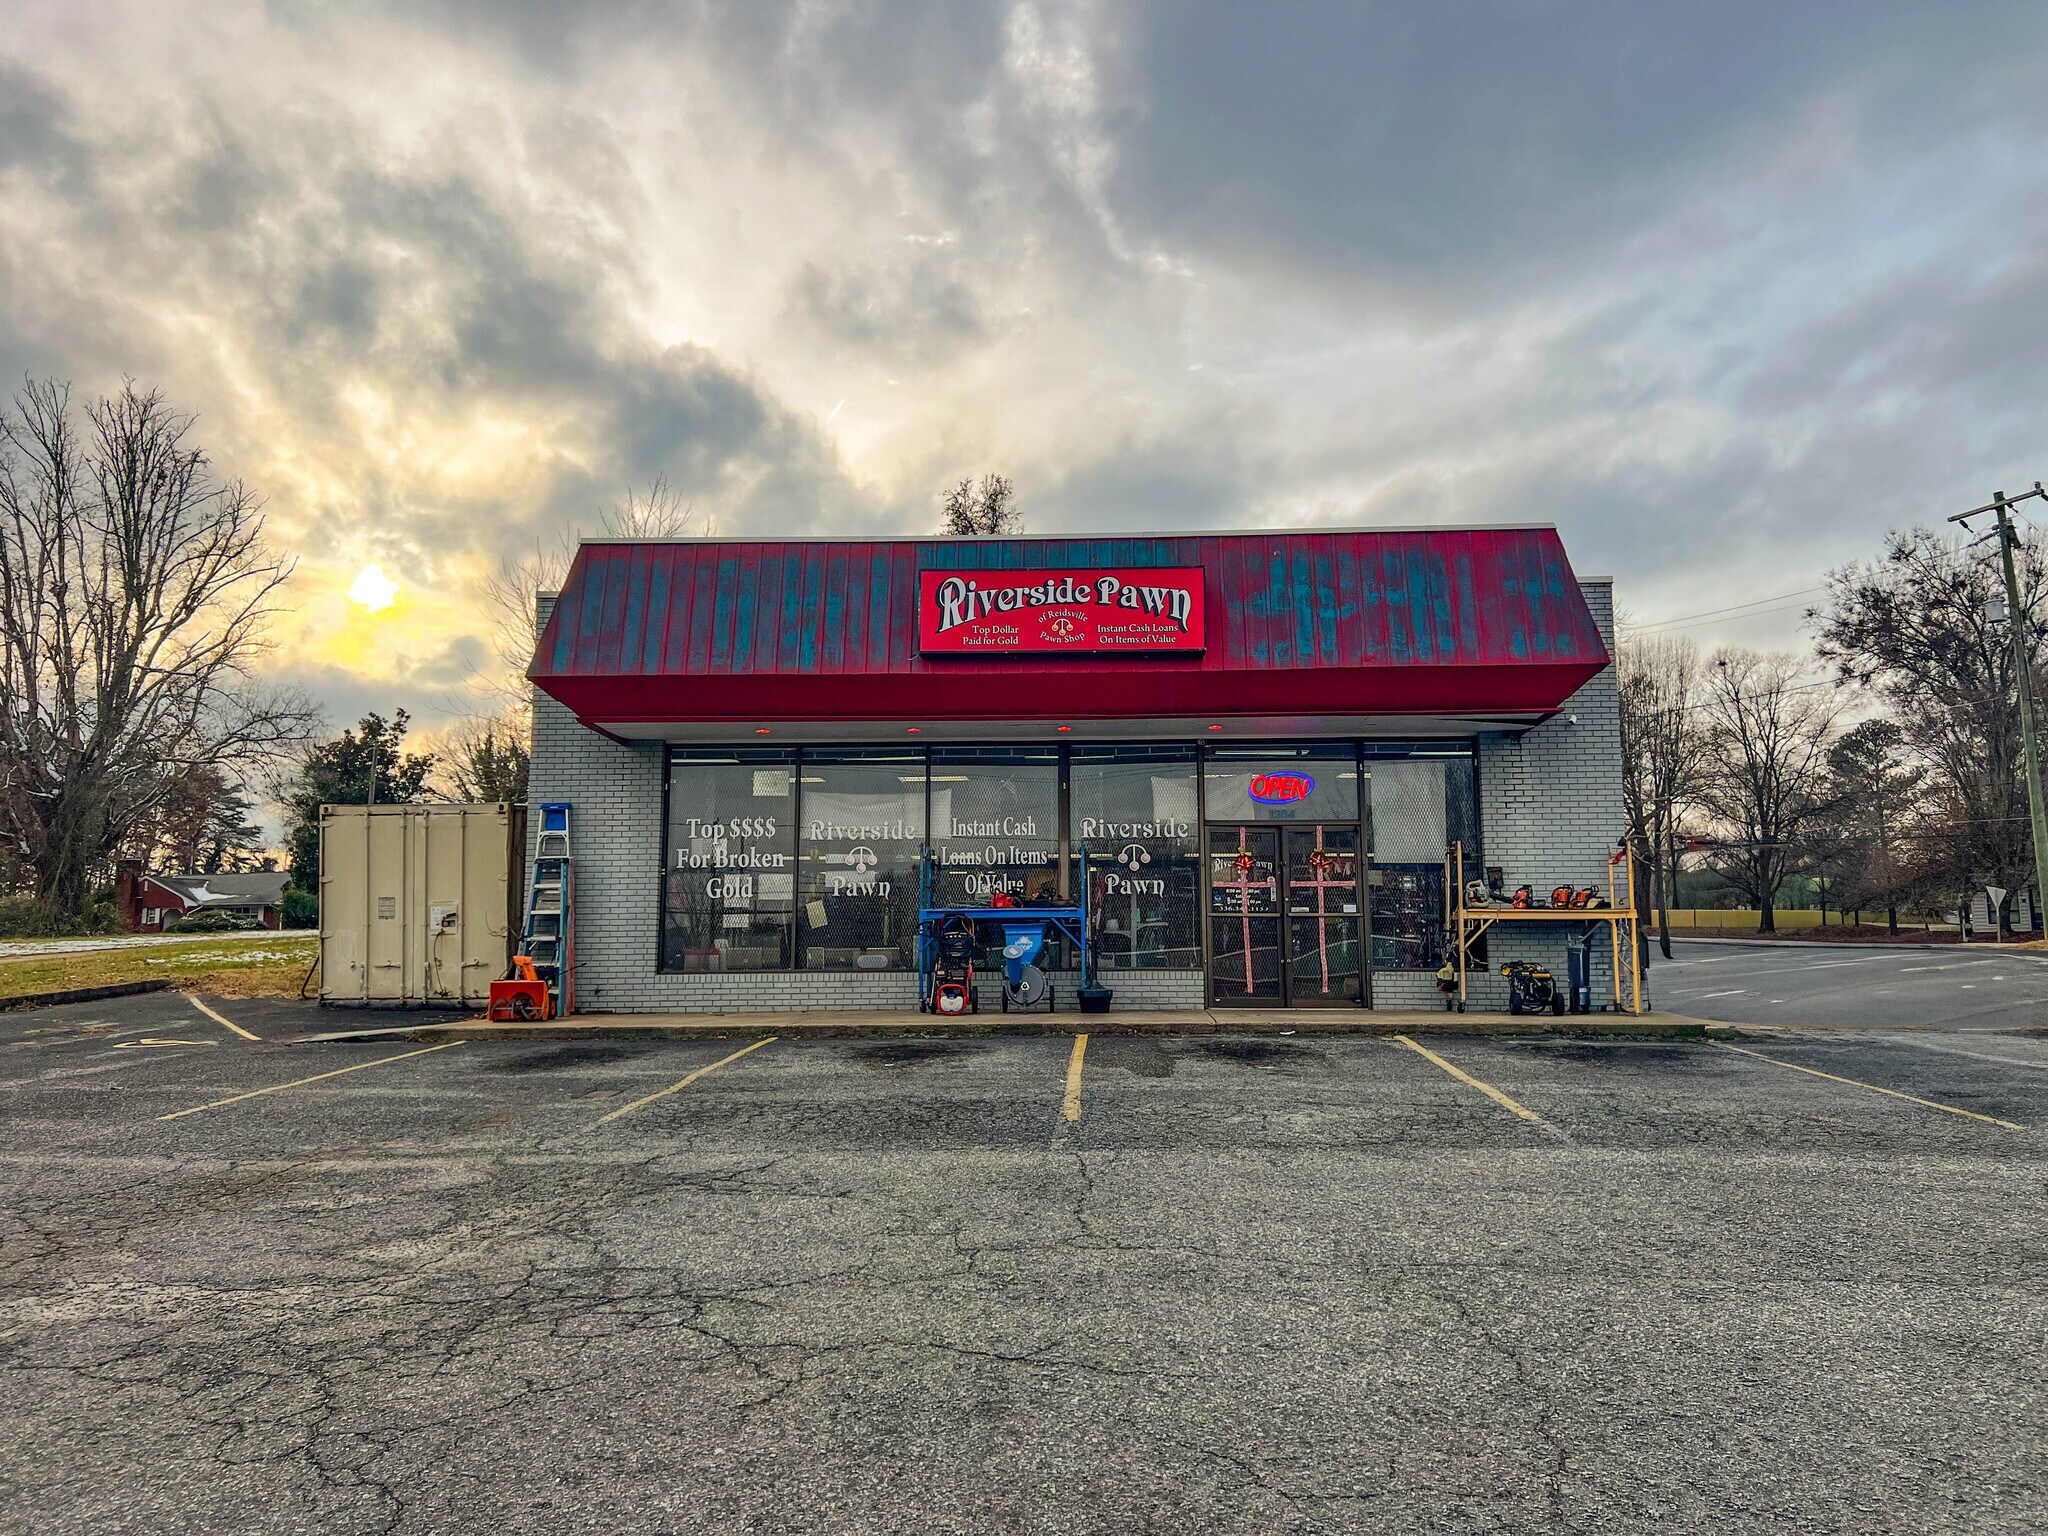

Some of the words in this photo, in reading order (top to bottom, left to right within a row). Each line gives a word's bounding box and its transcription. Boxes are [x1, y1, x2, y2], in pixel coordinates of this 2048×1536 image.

[938, 576, 1091, 633] Riverside
[1097, 576, 1192, 632] Pawn
[1038, 612, 1046, 622] of
[1047, 608, 1088, 622] Reidsville
[971, 625, 990, 636] Top
[992, 625, 1019, 634] Dollar
[1039, 630, 1061, 643] Pawn
[1063, 632, 1085, 643] Shop
[1097, 624, 1127, 633] Instant
[1129, 623, 1150, 632] Cash
[1152, 624, 1178, 632] Loans
[1099, 635, 1113, 644] On
[1115, 635, 1139, 643] Items
[1141, 634, 1151, 643] of
[1151, 634, 1177, 643] Value
[962, 636, 981, 645] Paid
[983, 636, 995, 645] for
[997, 636, 1019, 645] Gold
[1251, 774, 1309, 801] OPEN
[686, 818, 725, 845] Top
[729, 816, 776, 839] $$$$
[810, 819, 916, 840] Riverside
[952, 817, 1000, 837] Instant
[1003, 815, 1037, 836] Cash
[1080, 817, 1188, 839] Riverside
[676, 848, 711, 869] For
[714, 846, 785, 868] Broken
[941, 846, 982, 866] Loans
[985, 845, 1006, 865] On
[1009, 845, 1048, 865] Items
[706, 876, 753, 899] Gold
[831, 876, 891, 901] Pawn
[965, 872, 984, 895] Of
[984, 873, 1024, 894] Value
[1105, 873, 1165, 899] Pawn
